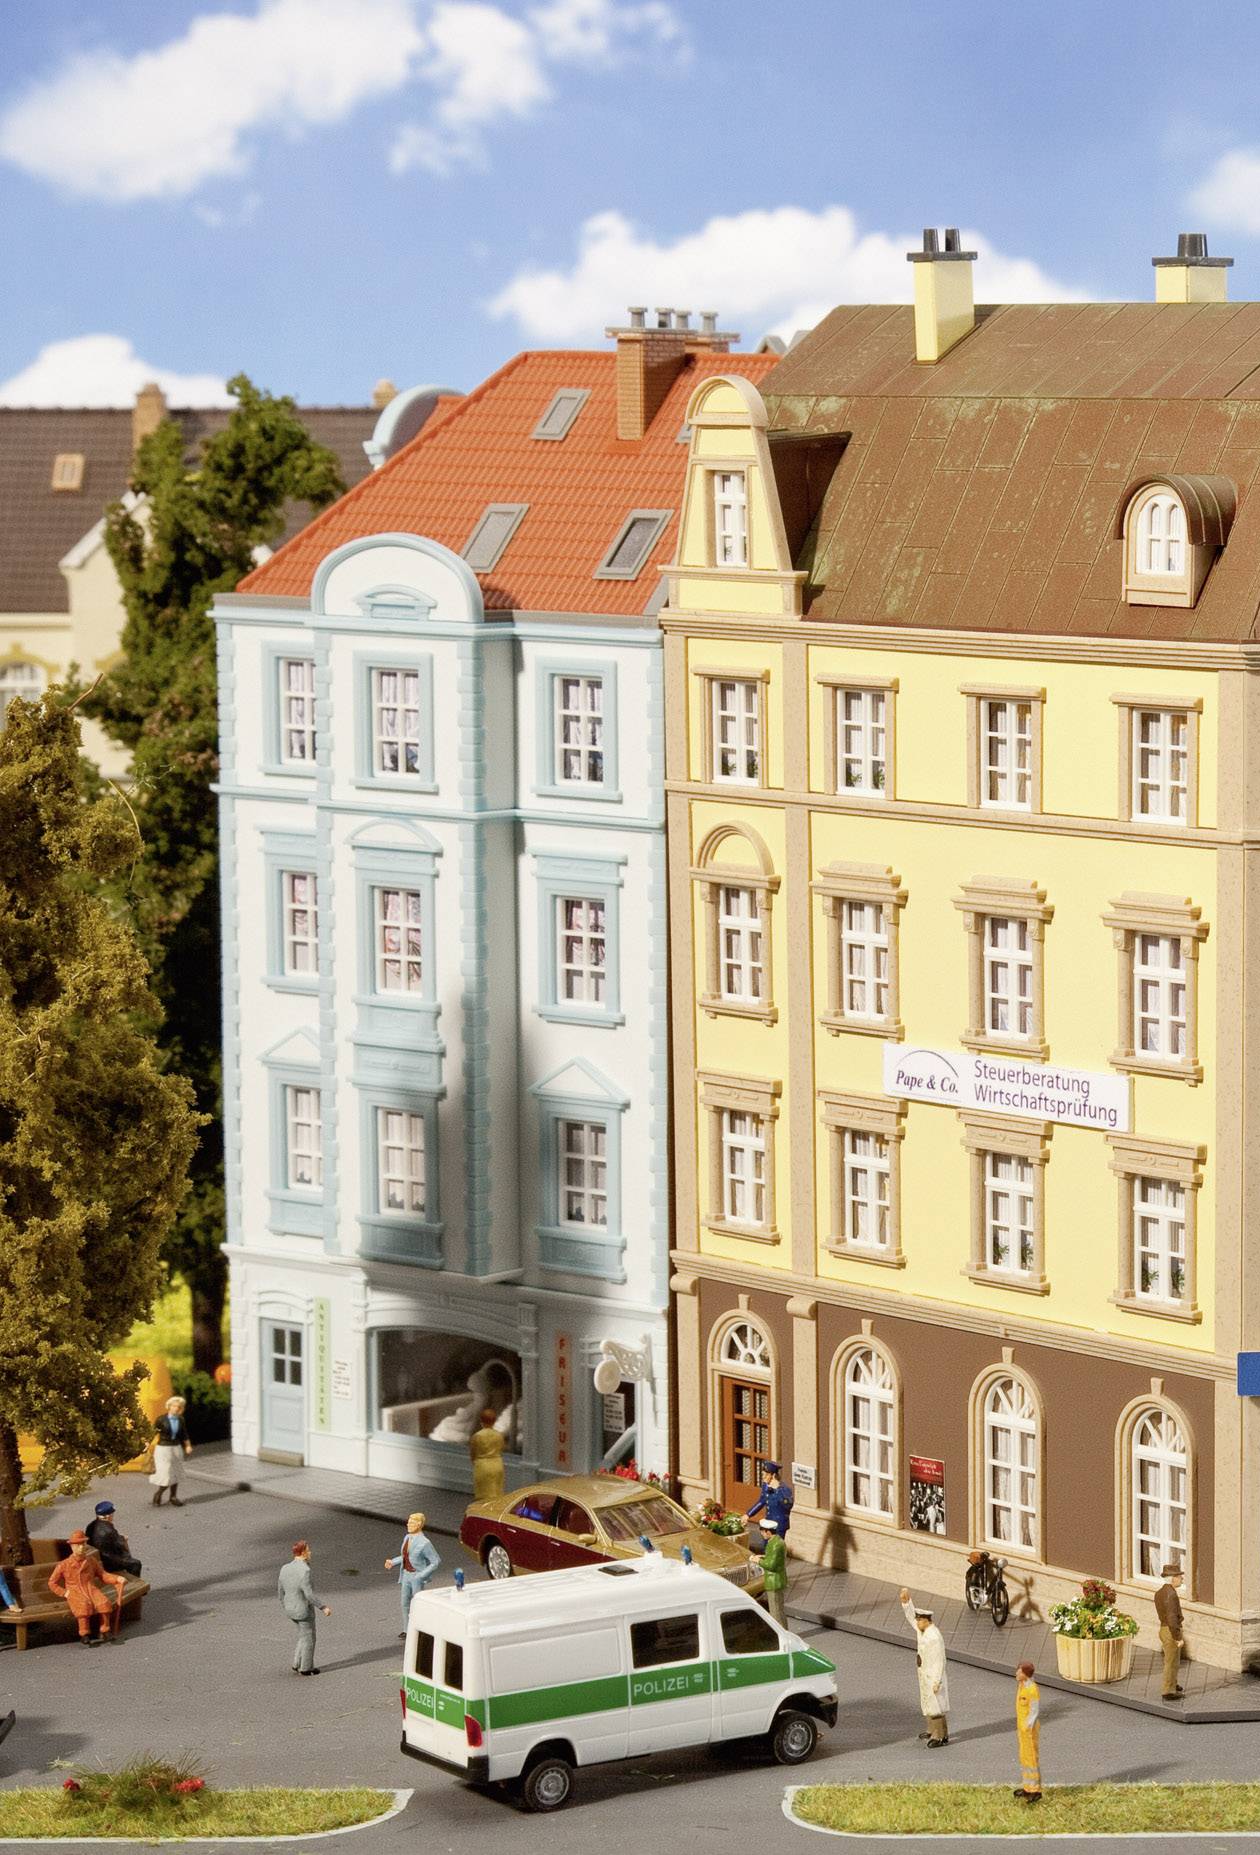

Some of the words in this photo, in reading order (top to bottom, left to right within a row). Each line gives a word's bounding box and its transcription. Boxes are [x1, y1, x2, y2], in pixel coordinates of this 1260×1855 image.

[895, 1069, 923, 1090] Pape
[926, 1077, 936, 1091] &
[940, 1078, 959, 1094] Co.
[974, 1059, 1090, 1099] Steuerberatung
[974, 1084, 1118, 1128] Wirtschaftsprüfung
[558, 1338, 567, 1463] FRISEUR
[406, 1687, 434, 1709] POLIZEI
[633, 1676, 689, 1697] POLIZEI
